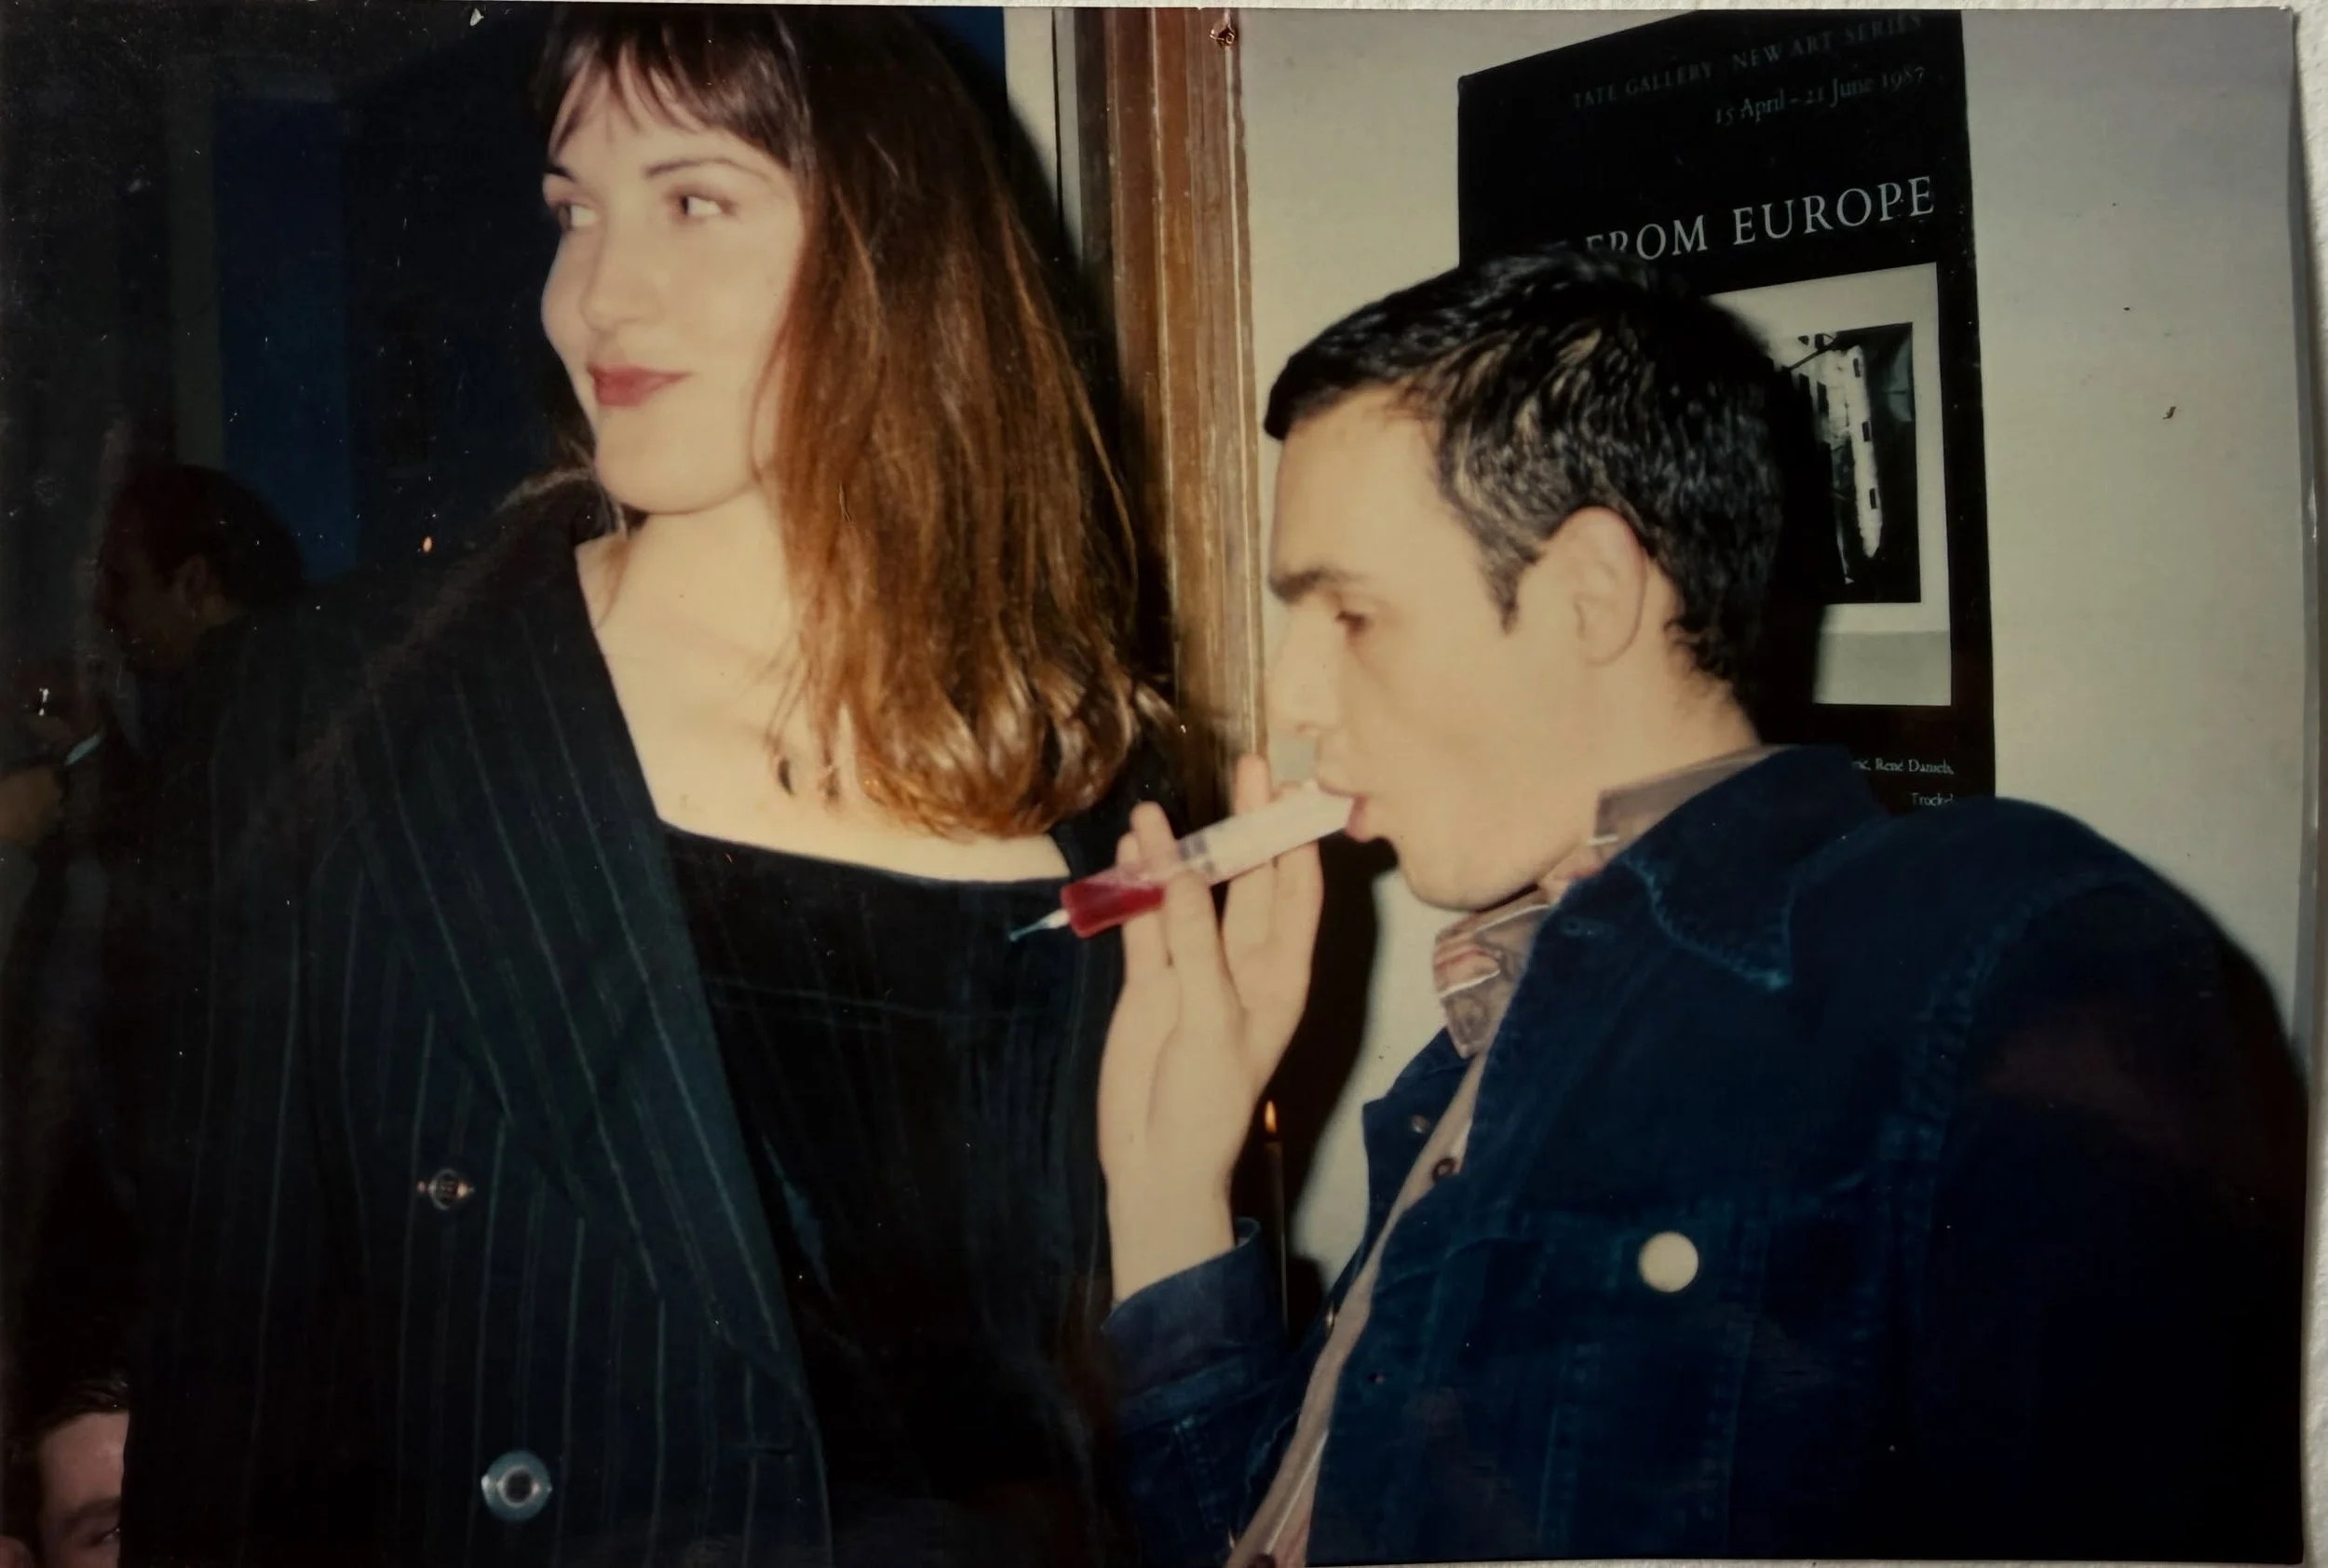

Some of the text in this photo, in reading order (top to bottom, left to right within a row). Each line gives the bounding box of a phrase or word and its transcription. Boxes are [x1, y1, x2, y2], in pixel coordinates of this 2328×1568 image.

[1573, 11, 1924, 110] TATE GALLERY NEW ART SERIES
[1715, 106, 1736, 128] 15
[1739, 87, 1786, 127] April
[1804, 86, 1825, 106] 21
[1829, 76, 1875, 109] June
[1881, 63, 1927, 92] 1987
[1732, 174, 1936, 247] EUROPE
